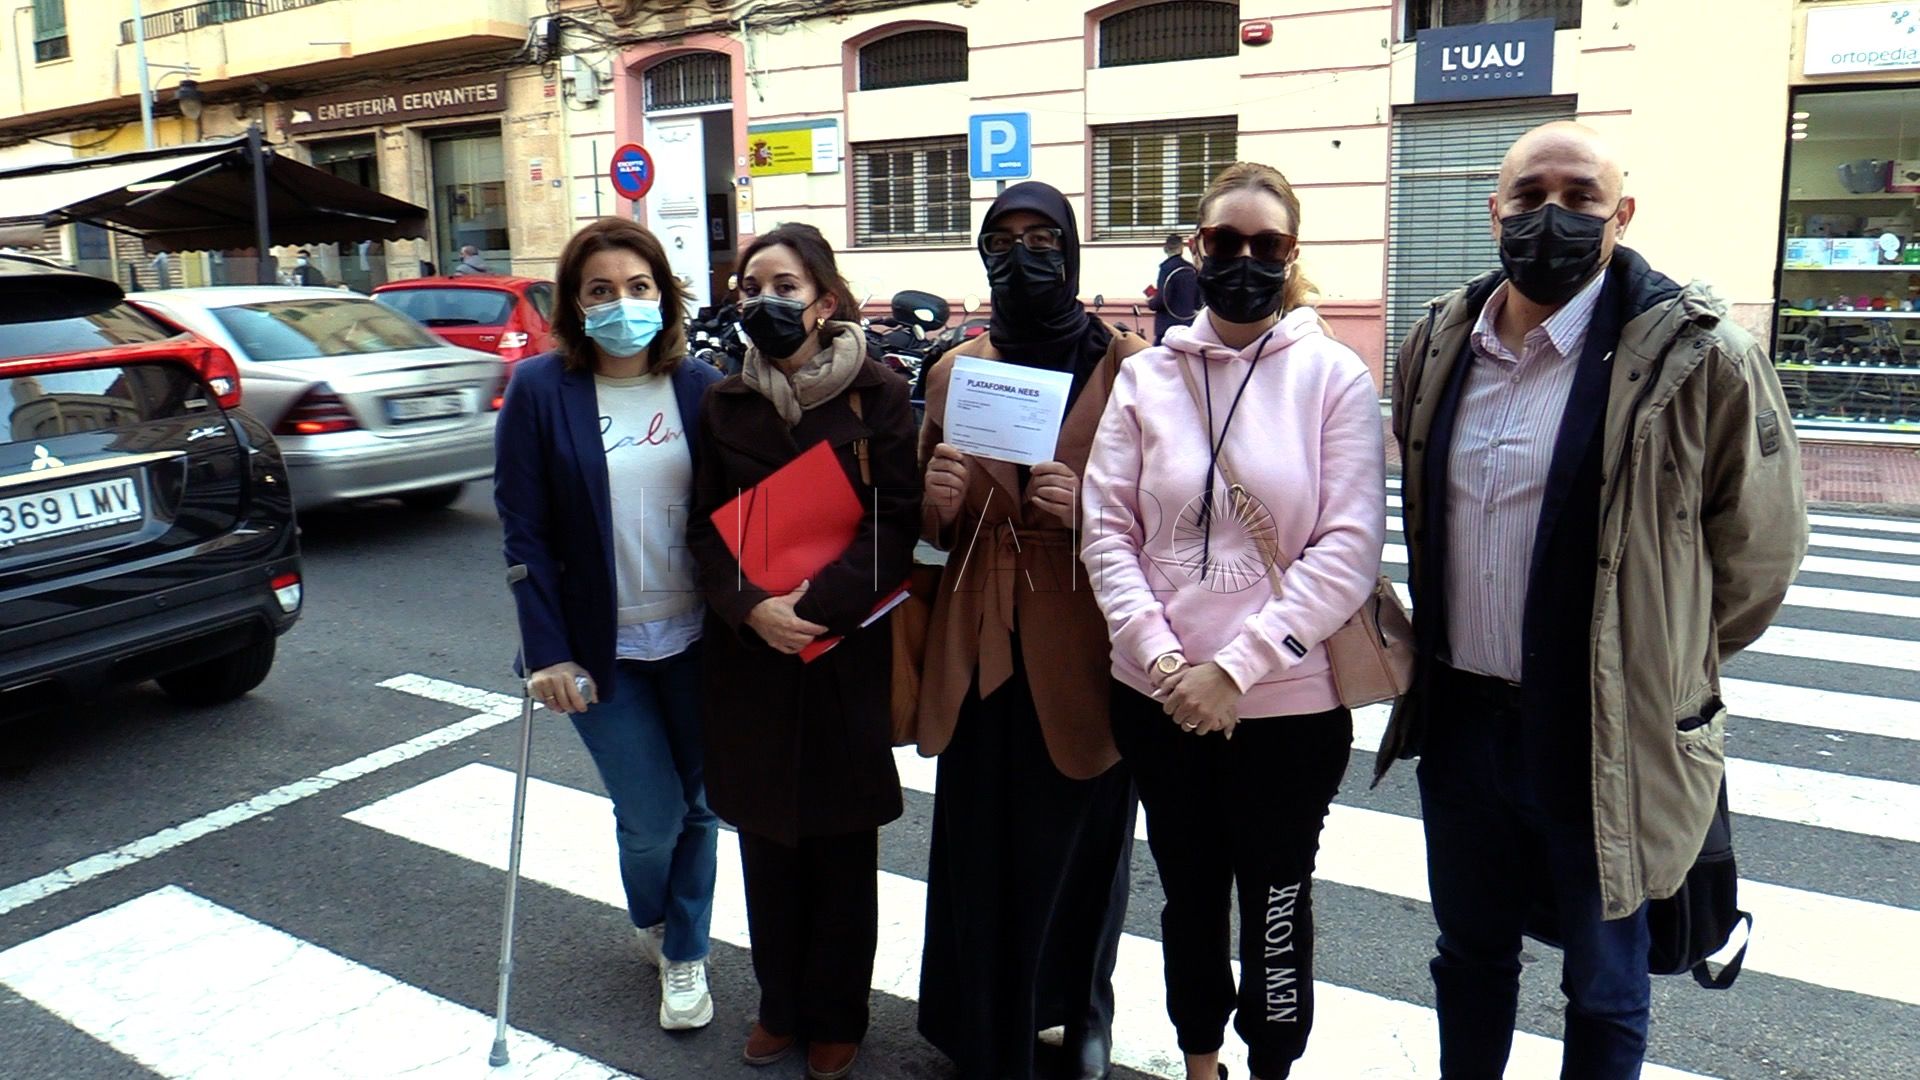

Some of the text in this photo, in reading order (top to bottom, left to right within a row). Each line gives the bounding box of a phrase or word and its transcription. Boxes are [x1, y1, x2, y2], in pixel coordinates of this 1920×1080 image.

[1831, 48, 1917, 65] ortopedia
[402, 83, 498, 111] CERVANTES
[981, 120, 1017, 172] P
[966, 379, 1017, 394] PLATAFORMA
[1017, 387, 1041, 398] NEES
[70, 482, 130, 519] LMV
[1264, 882, 1302, 1023] NEW YORK
